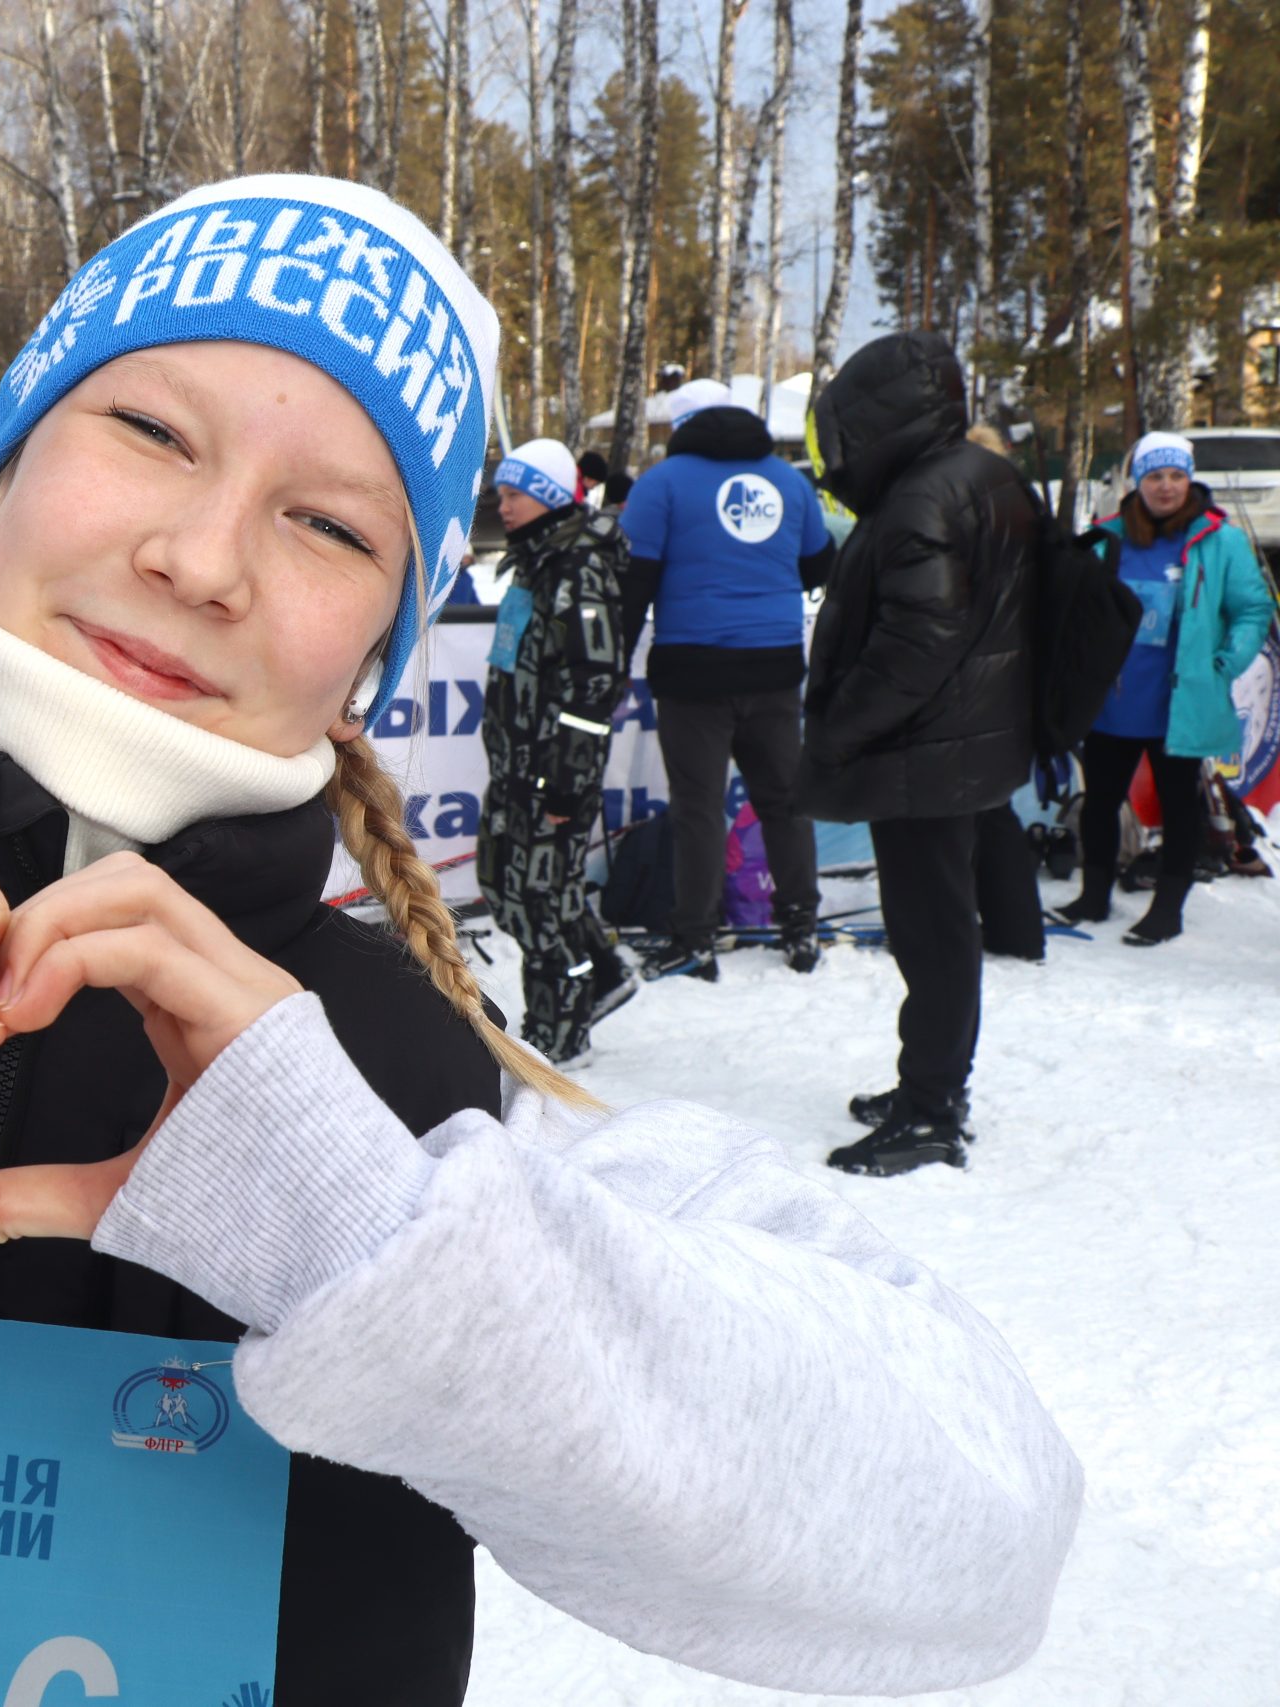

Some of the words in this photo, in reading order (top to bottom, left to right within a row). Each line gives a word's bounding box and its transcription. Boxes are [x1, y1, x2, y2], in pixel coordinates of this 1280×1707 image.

[114, 251, 462, 469] РОССИИ
[136, 207, 473, 428] ЛЫЖНЯ
[144, 1437, 184, 1452] ФЛГР
